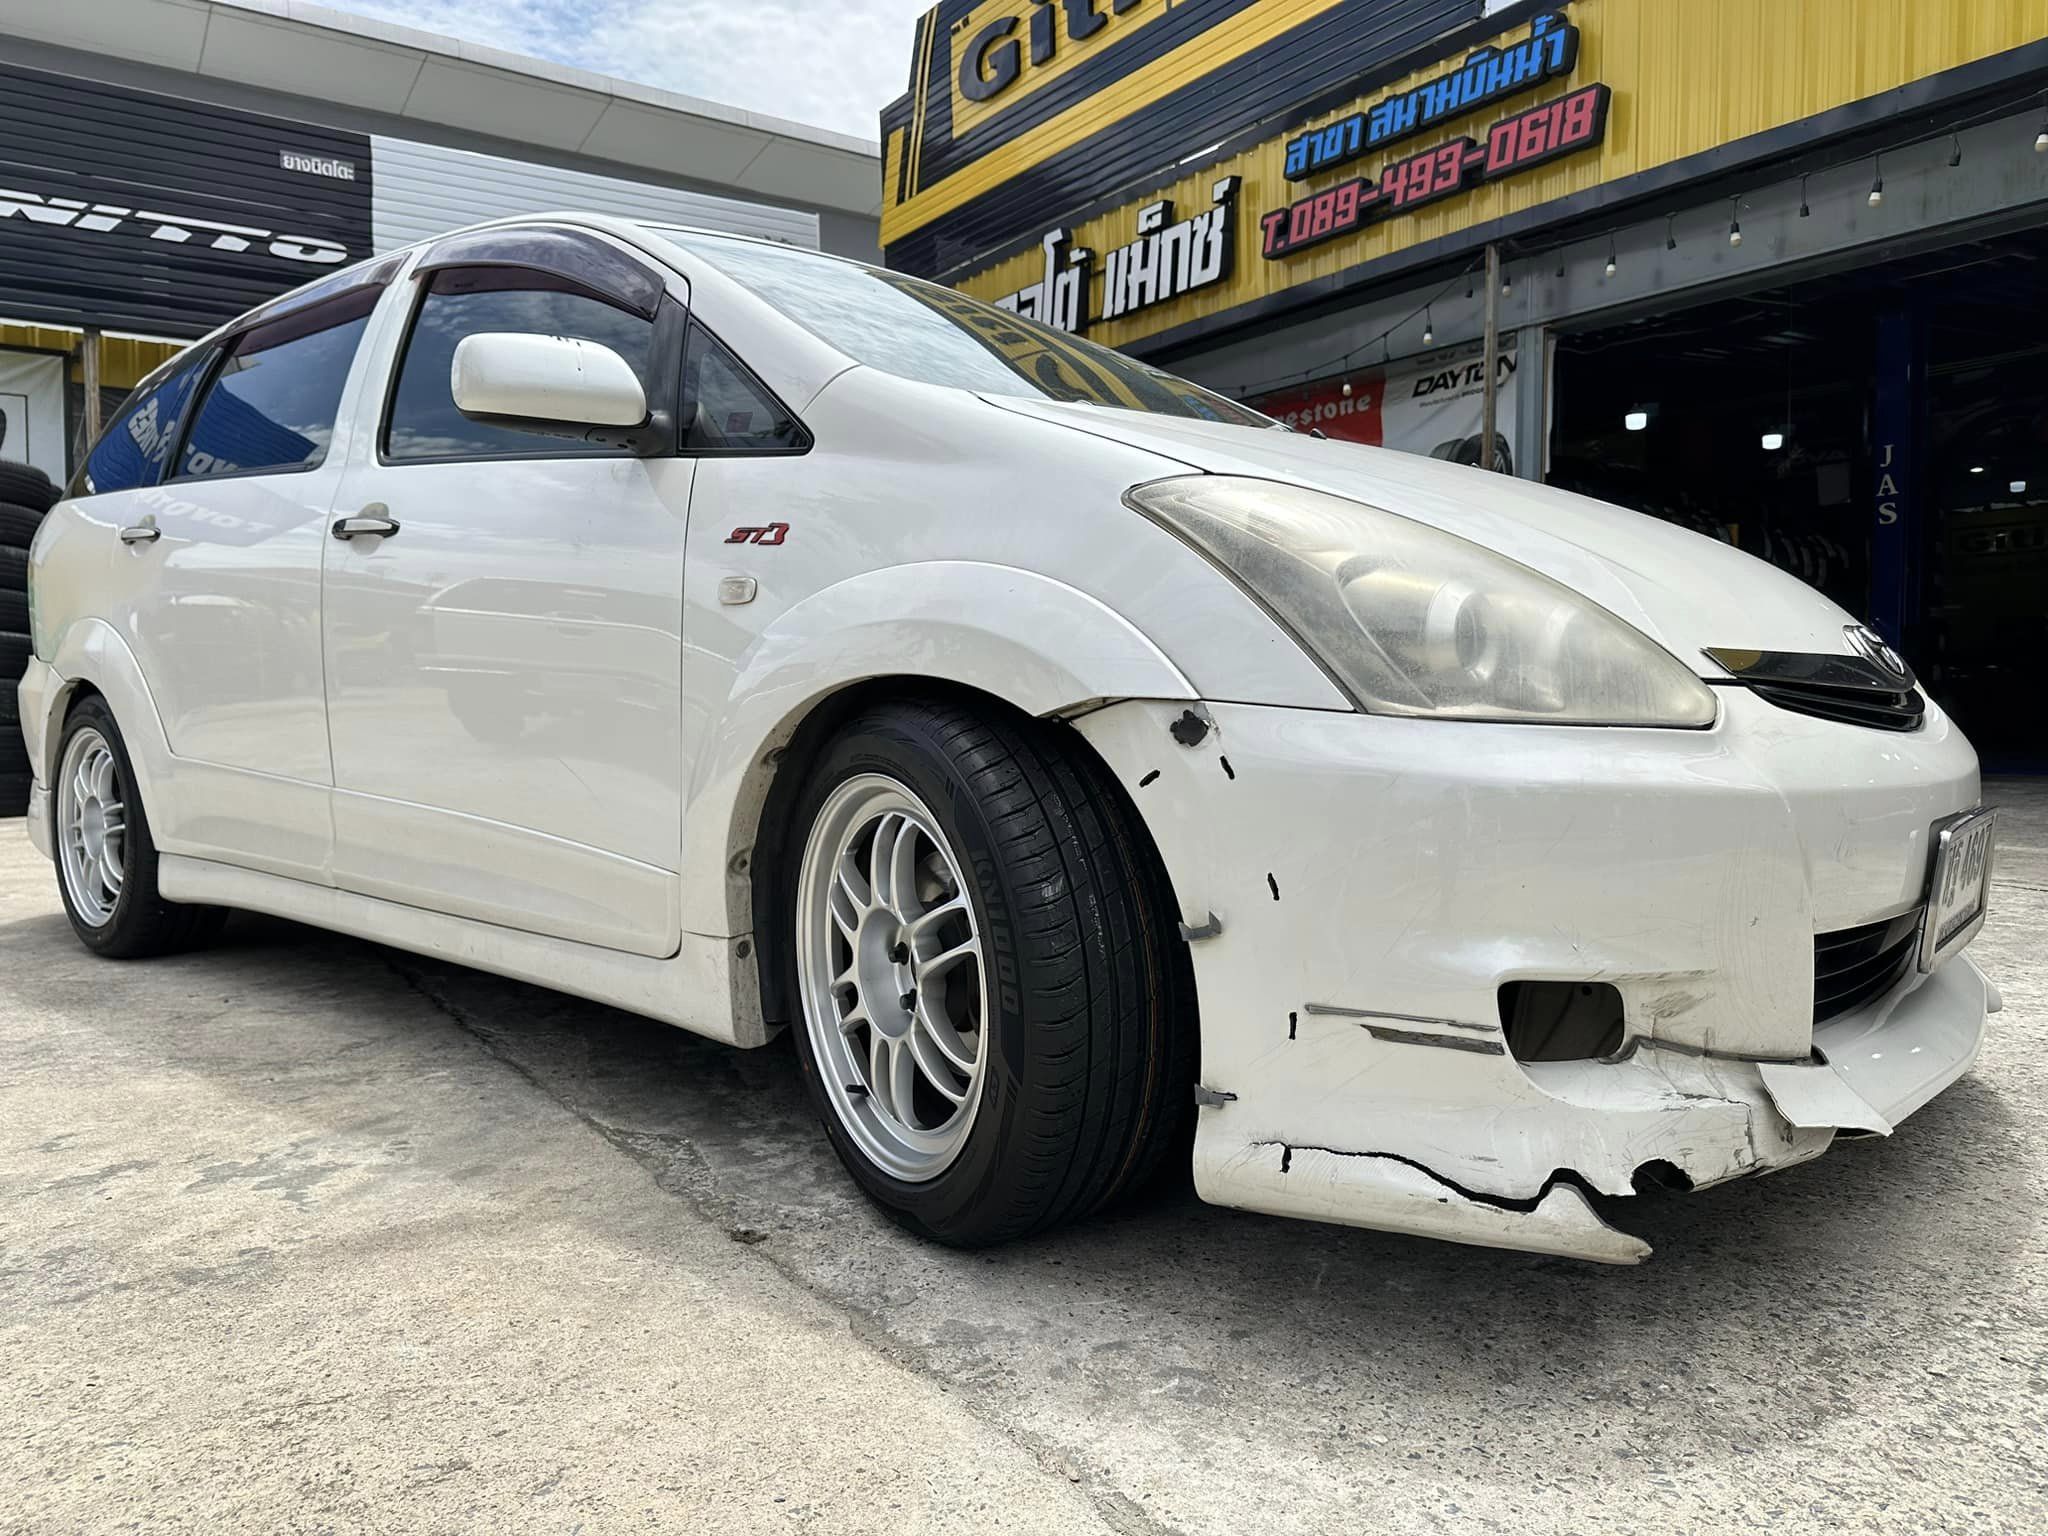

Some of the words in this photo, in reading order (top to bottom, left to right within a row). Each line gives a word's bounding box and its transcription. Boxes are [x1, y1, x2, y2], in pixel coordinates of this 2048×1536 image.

[1263, 88, 1598, 254] T.089-493-0618
[1286, 115, 1364, 176] สาขา
[1369, 14, 1567, 144] สนามบินน้ำ
[1876, 443, 1900, 525] JAS
